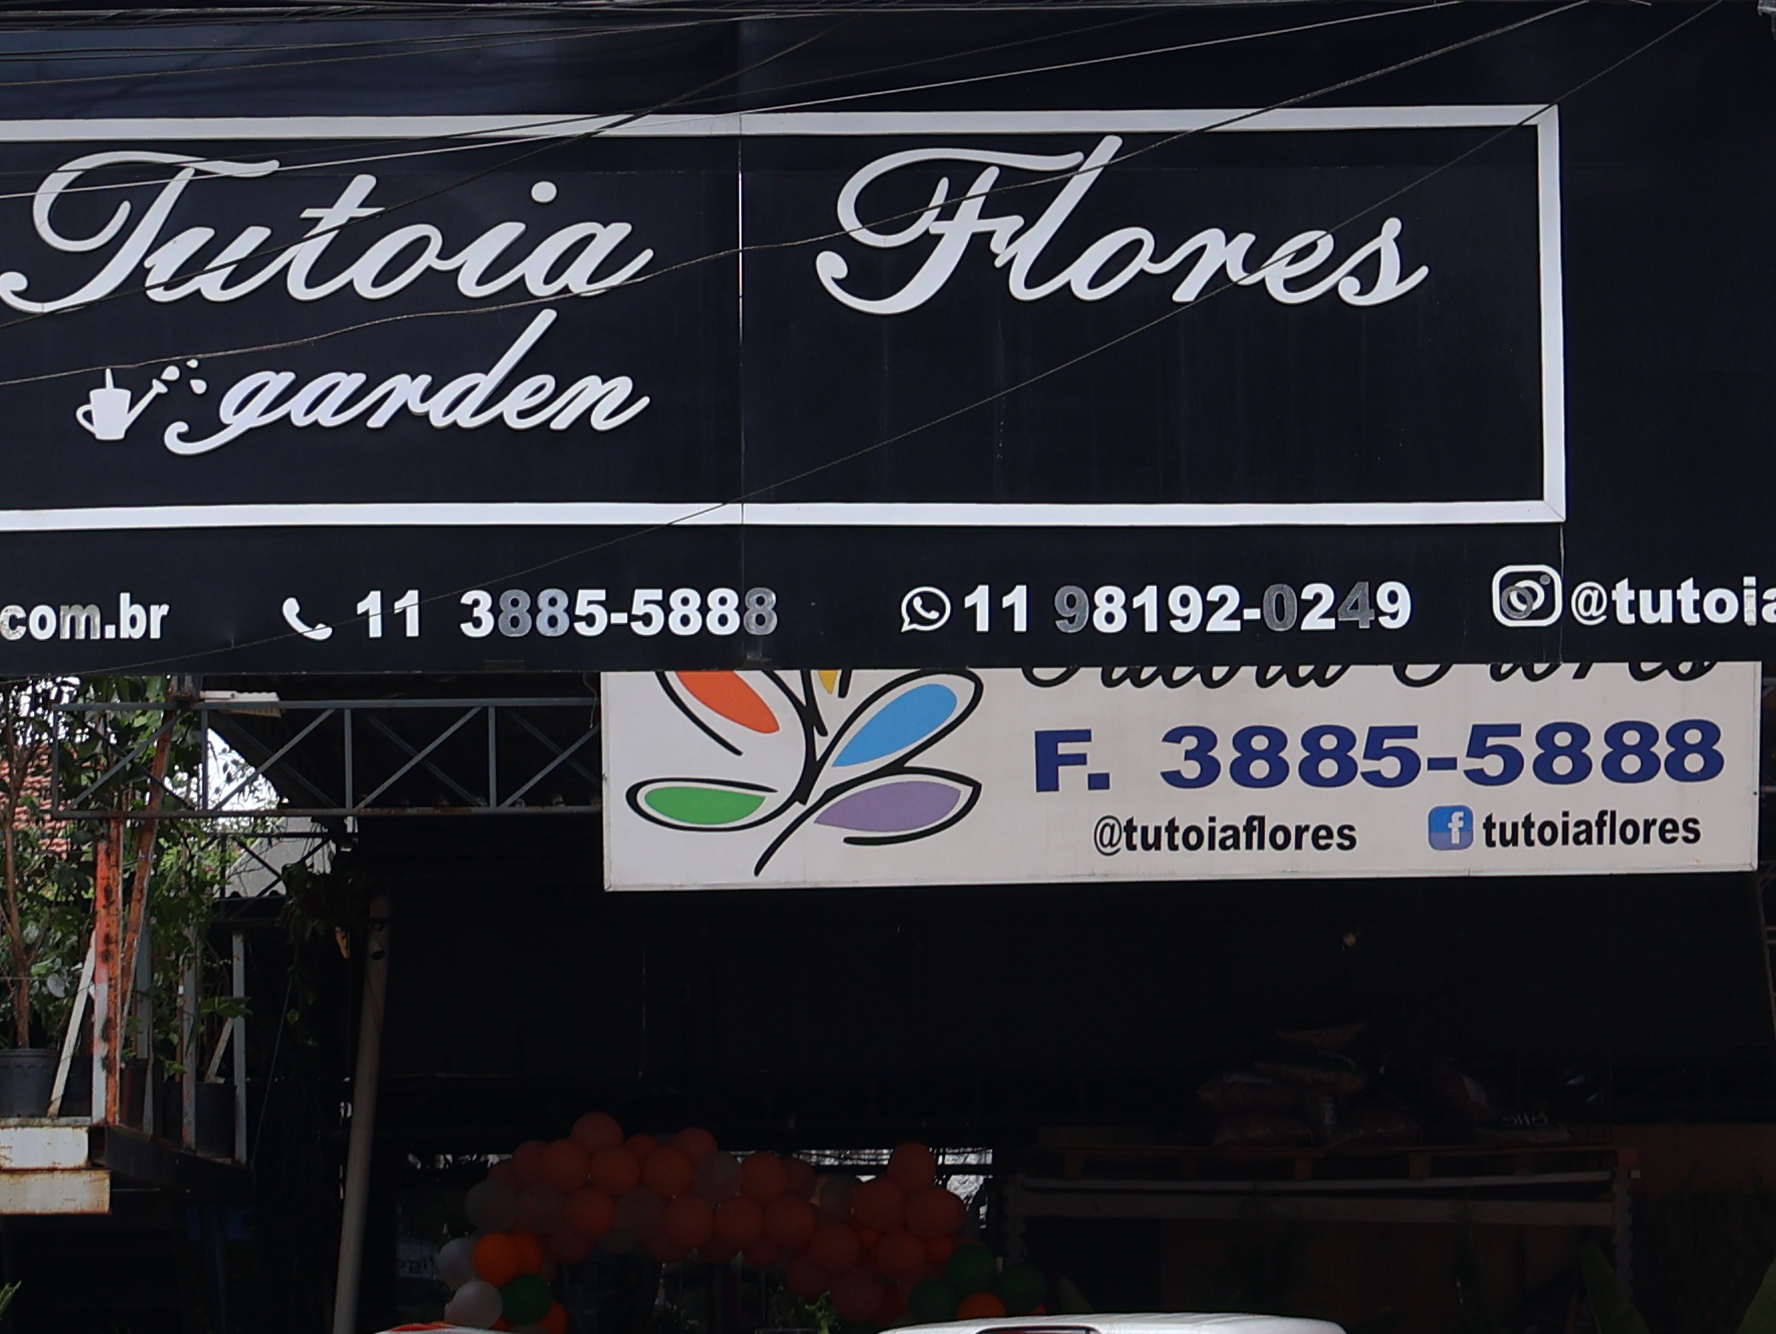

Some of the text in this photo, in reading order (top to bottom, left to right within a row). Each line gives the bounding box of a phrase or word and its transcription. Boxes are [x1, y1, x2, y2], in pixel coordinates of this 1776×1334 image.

[815, 133, 1430, 315] Flores
[164, 308, 650, 455] garden
[356, 587, 779, 639] 11 3885-5888
[964, 581, 1412, 634] 11 98192-0249
[1033, 718, 1726, 793] F. 3885-5888
[1093, 808, 1702, 857] @tutoiaflores tutoiaflores
